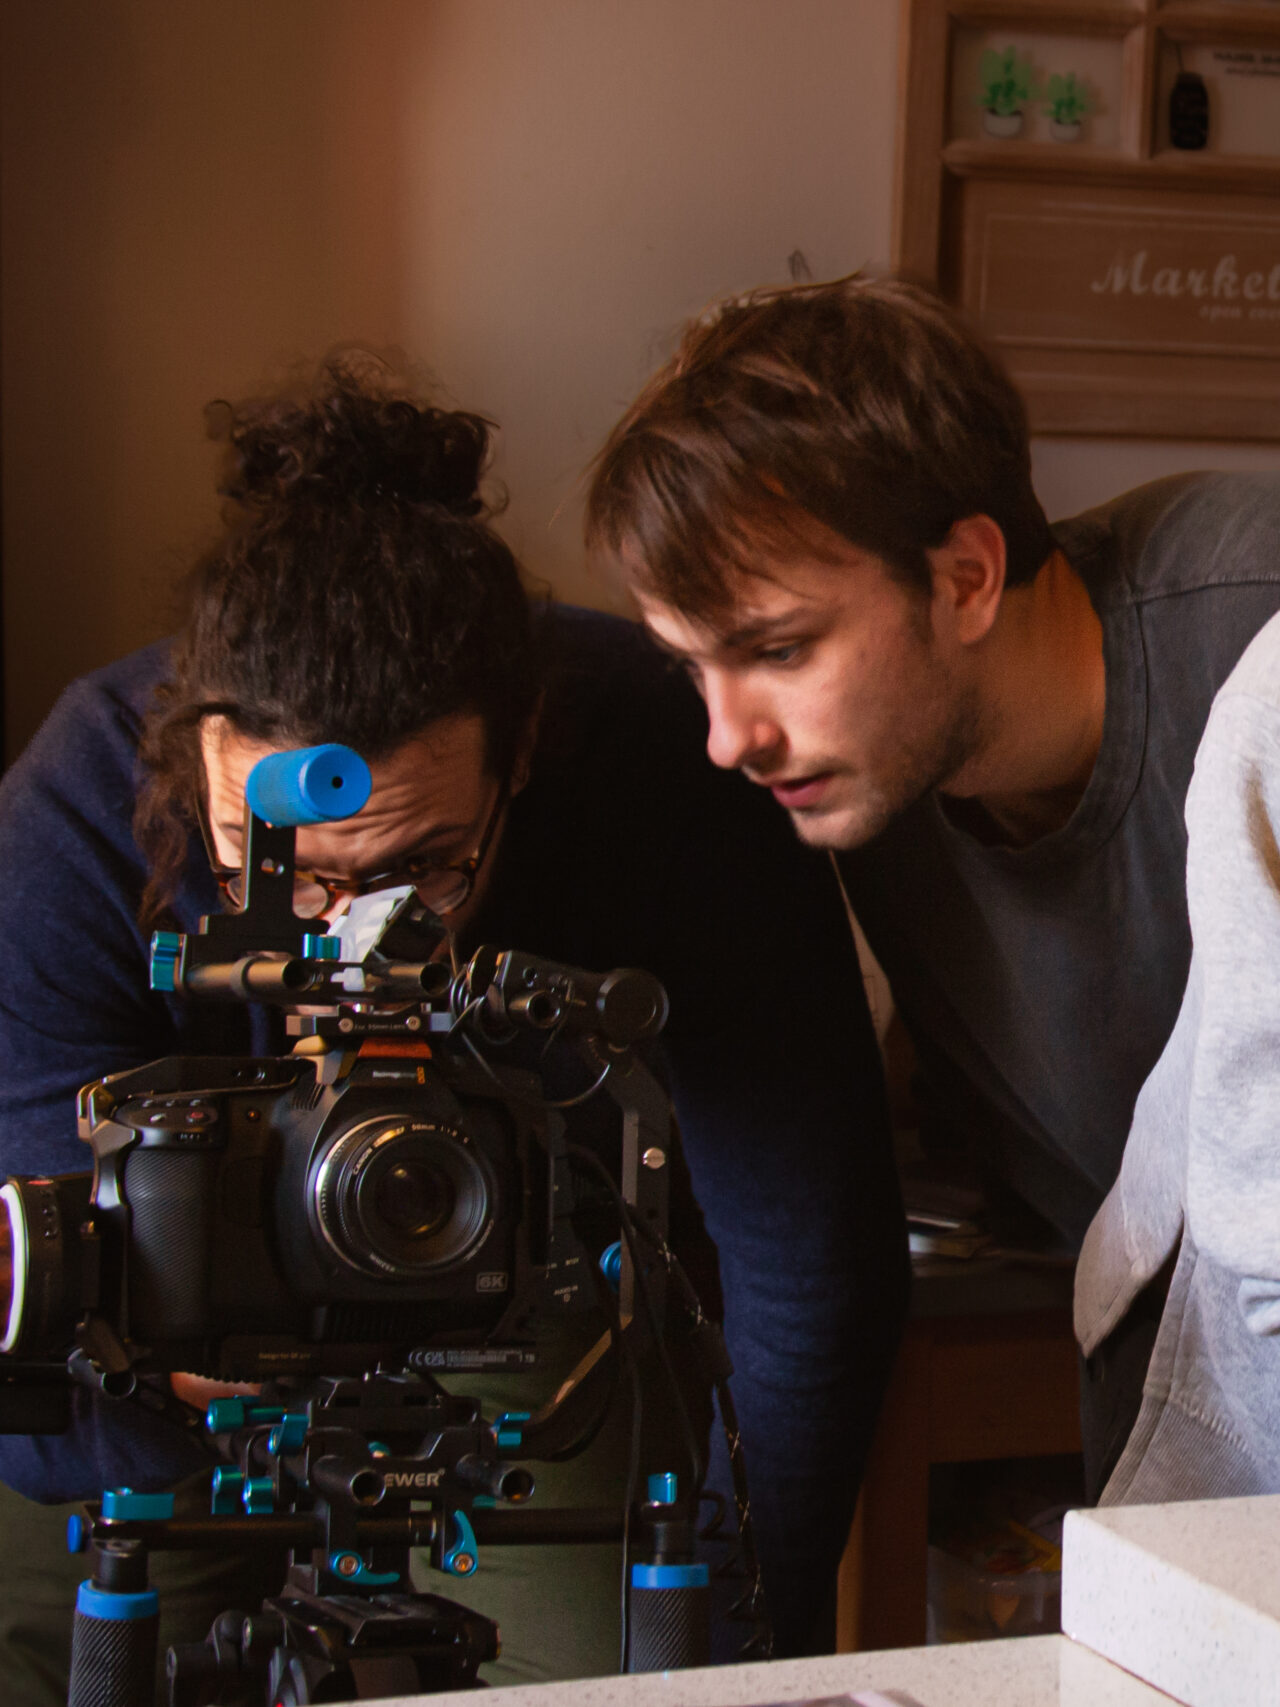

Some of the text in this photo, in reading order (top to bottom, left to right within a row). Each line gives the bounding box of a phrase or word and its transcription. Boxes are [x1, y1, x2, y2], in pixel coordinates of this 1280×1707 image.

[1200, 305, 1241, 322] open
[479, 1275, 504, 1289] 6K
[384, 1471, 440, 1488] EWER
